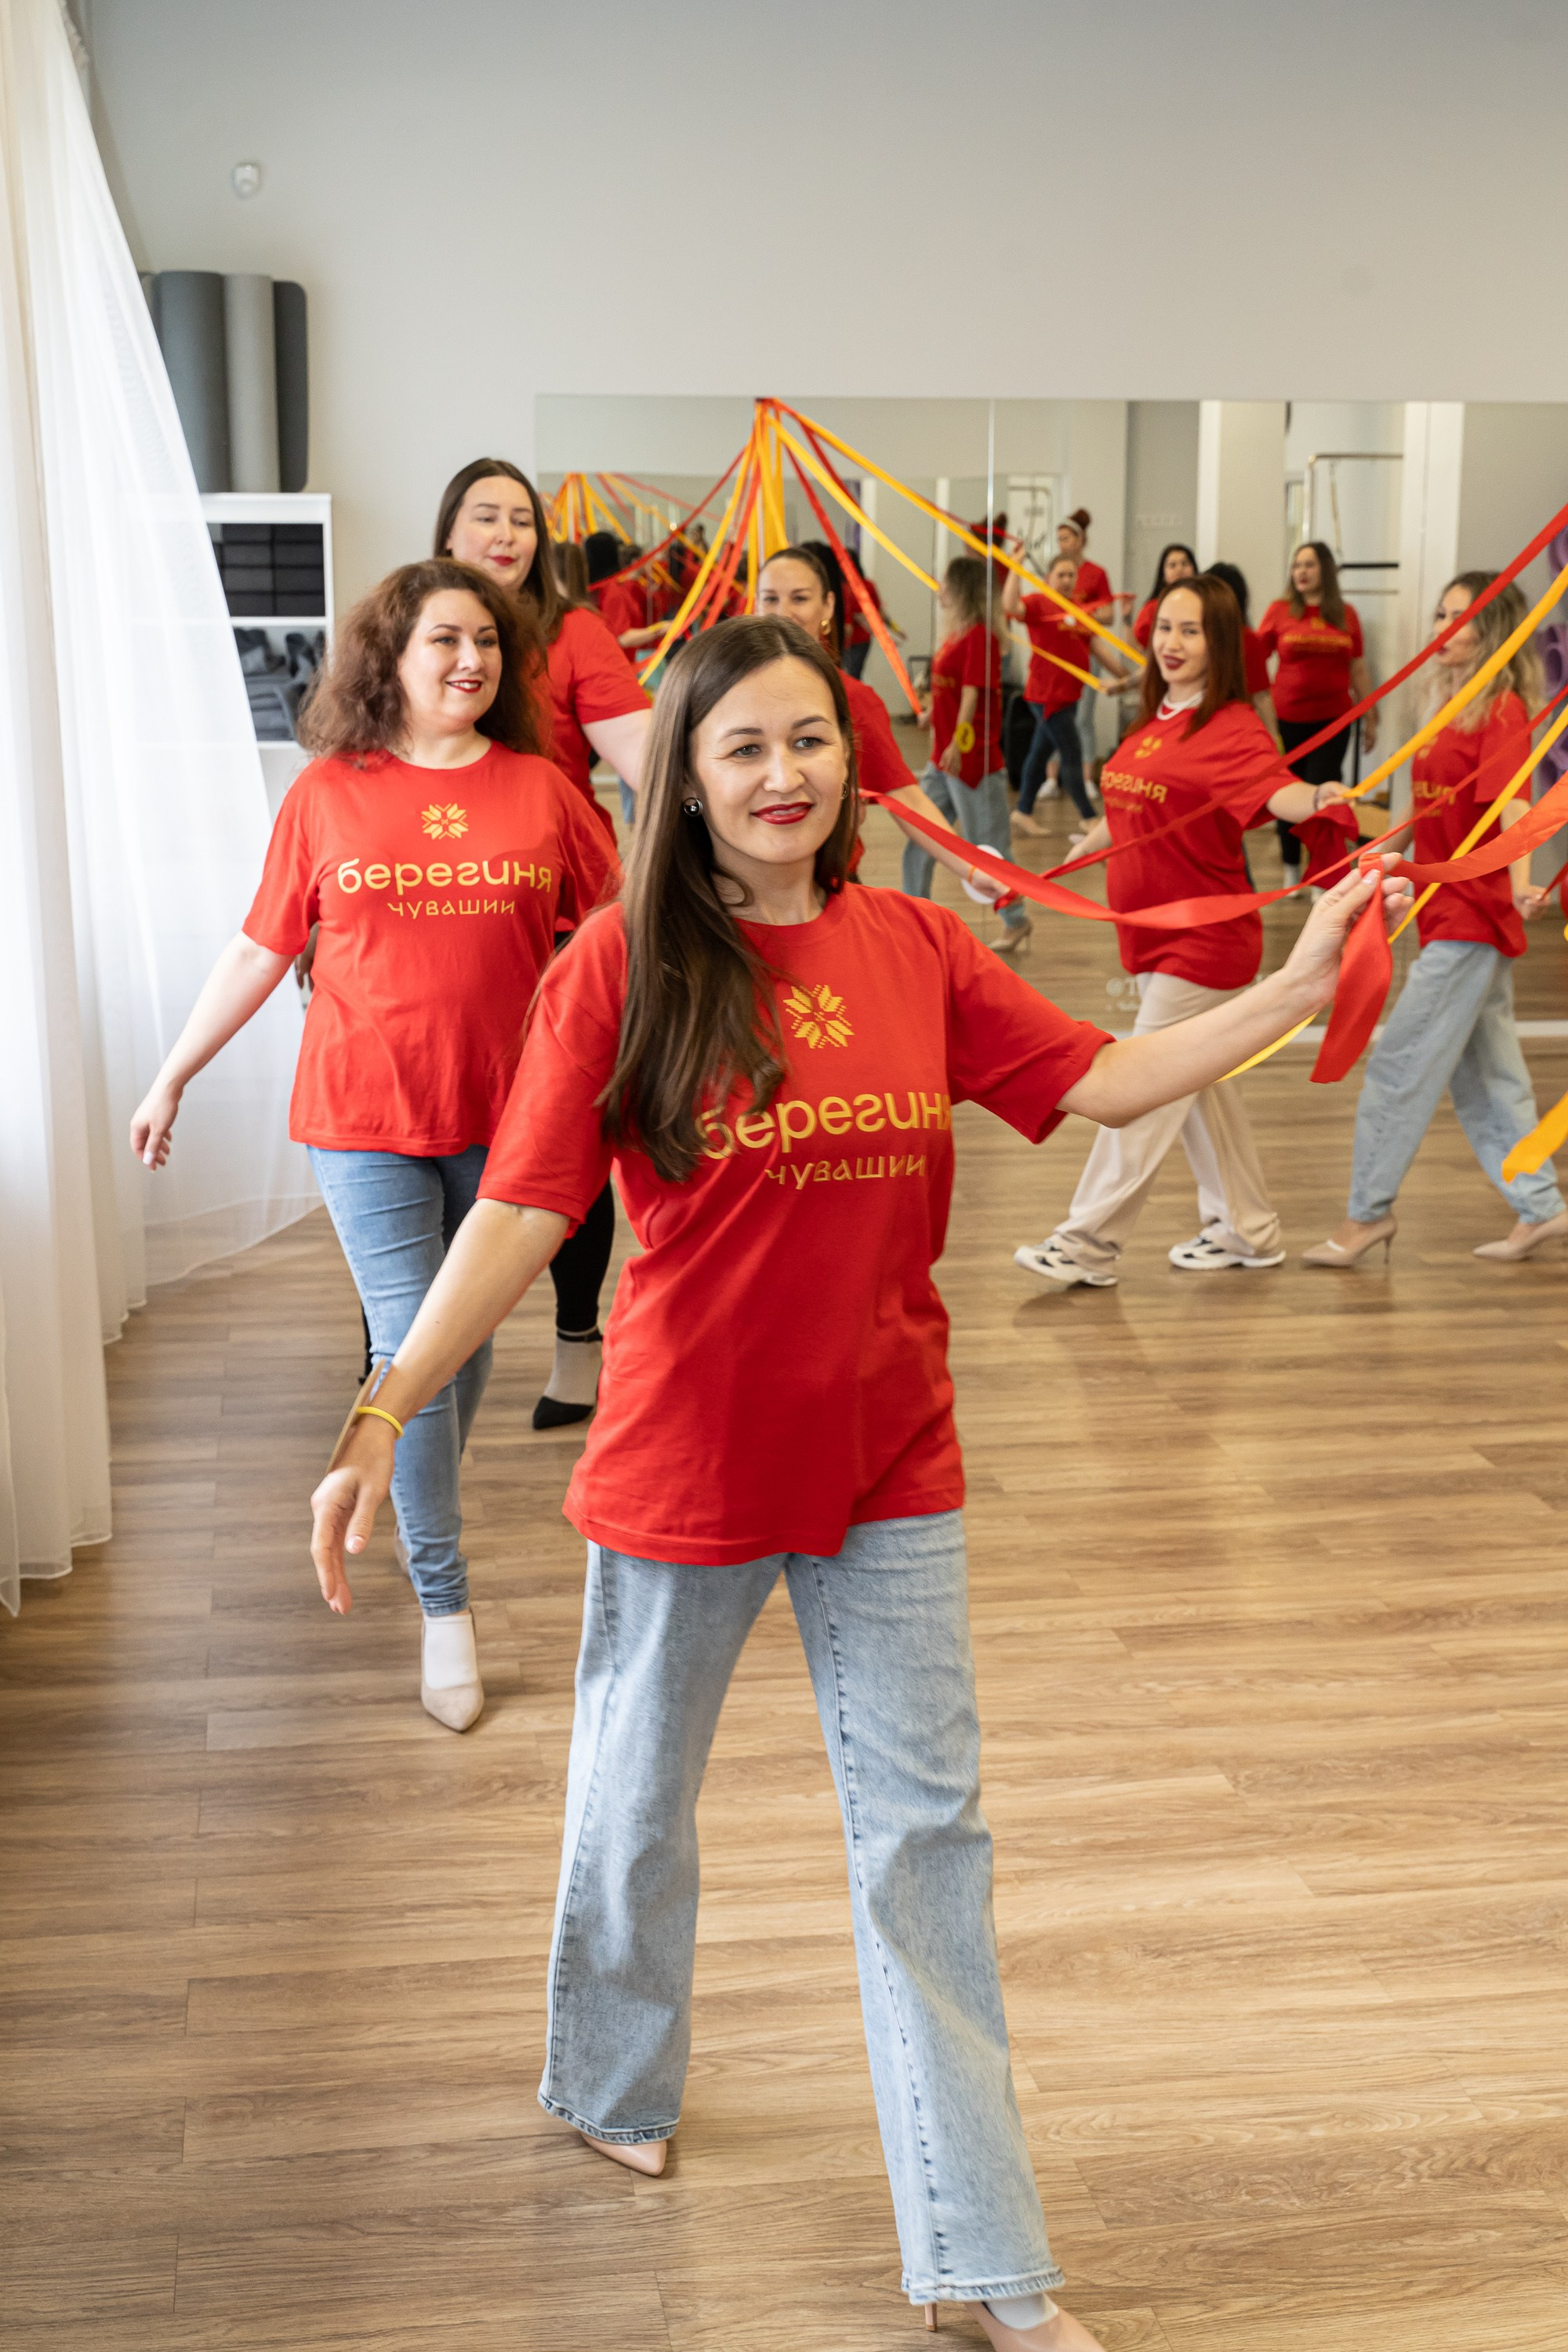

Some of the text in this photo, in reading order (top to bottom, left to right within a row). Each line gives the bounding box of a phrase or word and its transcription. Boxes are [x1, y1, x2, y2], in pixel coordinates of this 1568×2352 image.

[337, 858, 552, 895] берегиня
[387, 898, 515, 920] чувашии
[764, 1154, 927, 1190] чувашии
